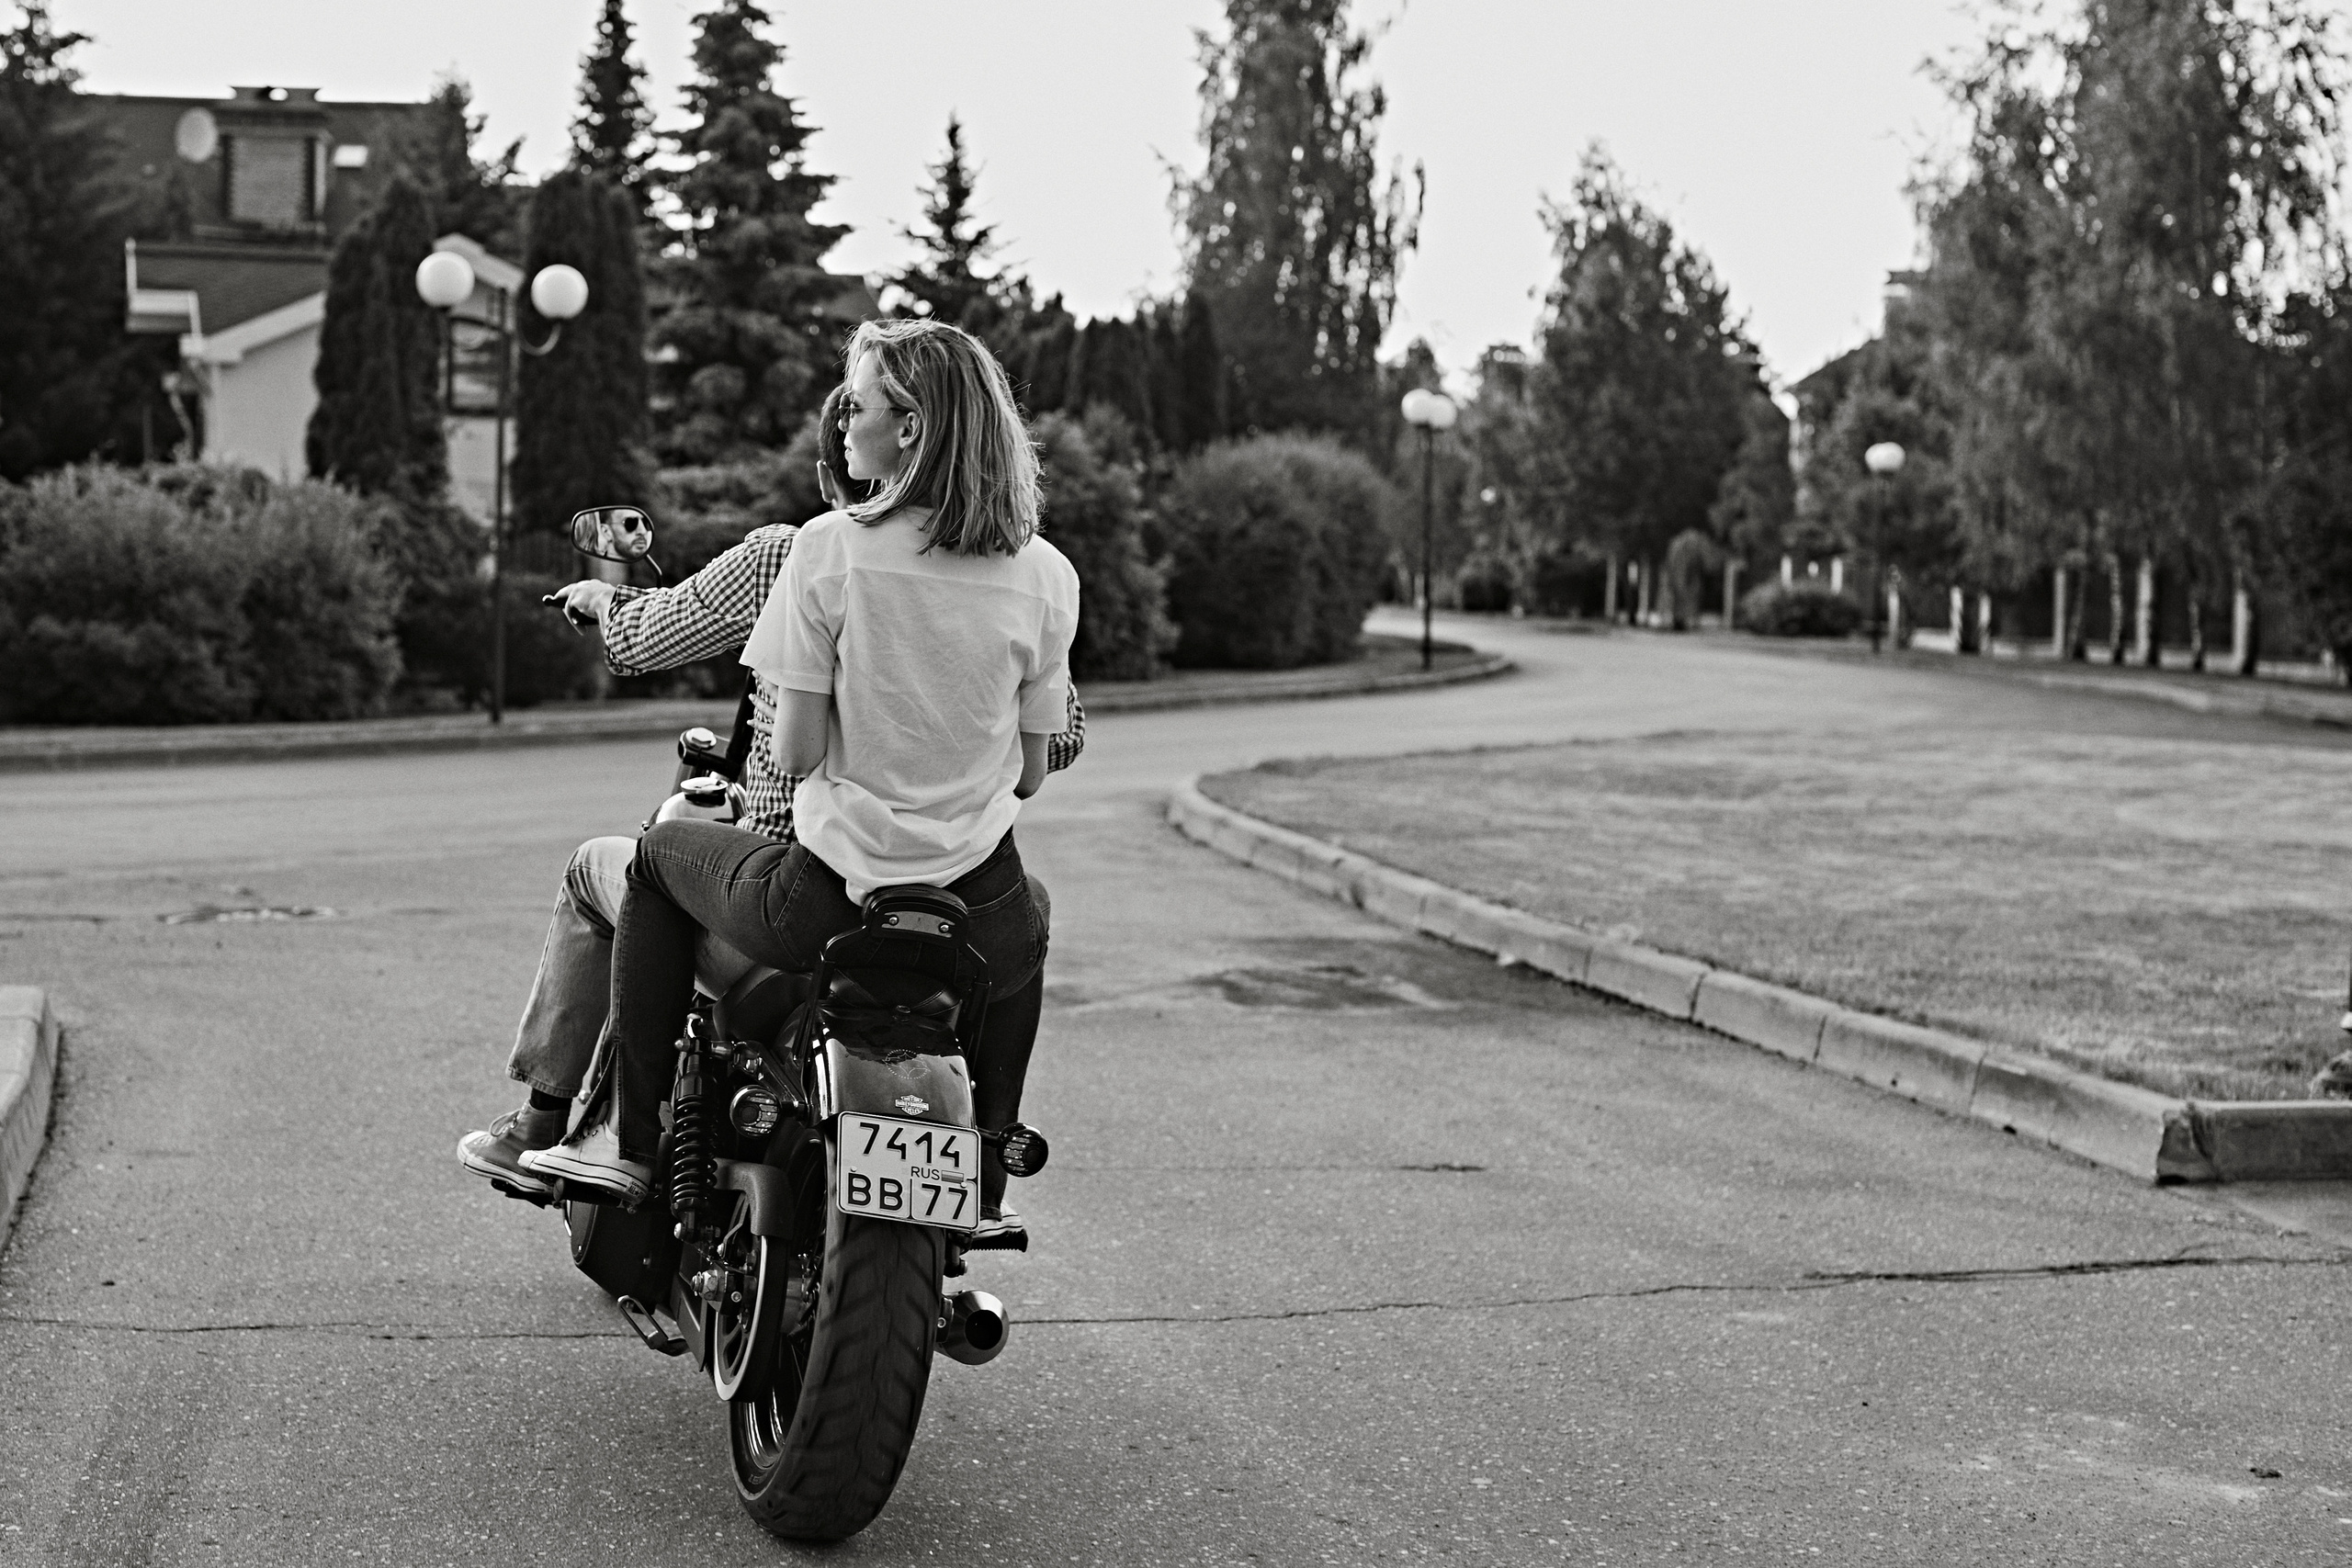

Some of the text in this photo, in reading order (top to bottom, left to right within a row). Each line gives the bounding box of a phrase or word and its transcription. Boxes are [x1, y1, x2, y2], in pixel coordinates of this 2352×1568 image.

[859, 1122, 960, 1168] 7414
[847, 1172, 903, 1211] BB
[910, 1166, 940, 1180] RUS
[922, 1183, 968, 1220] 77
